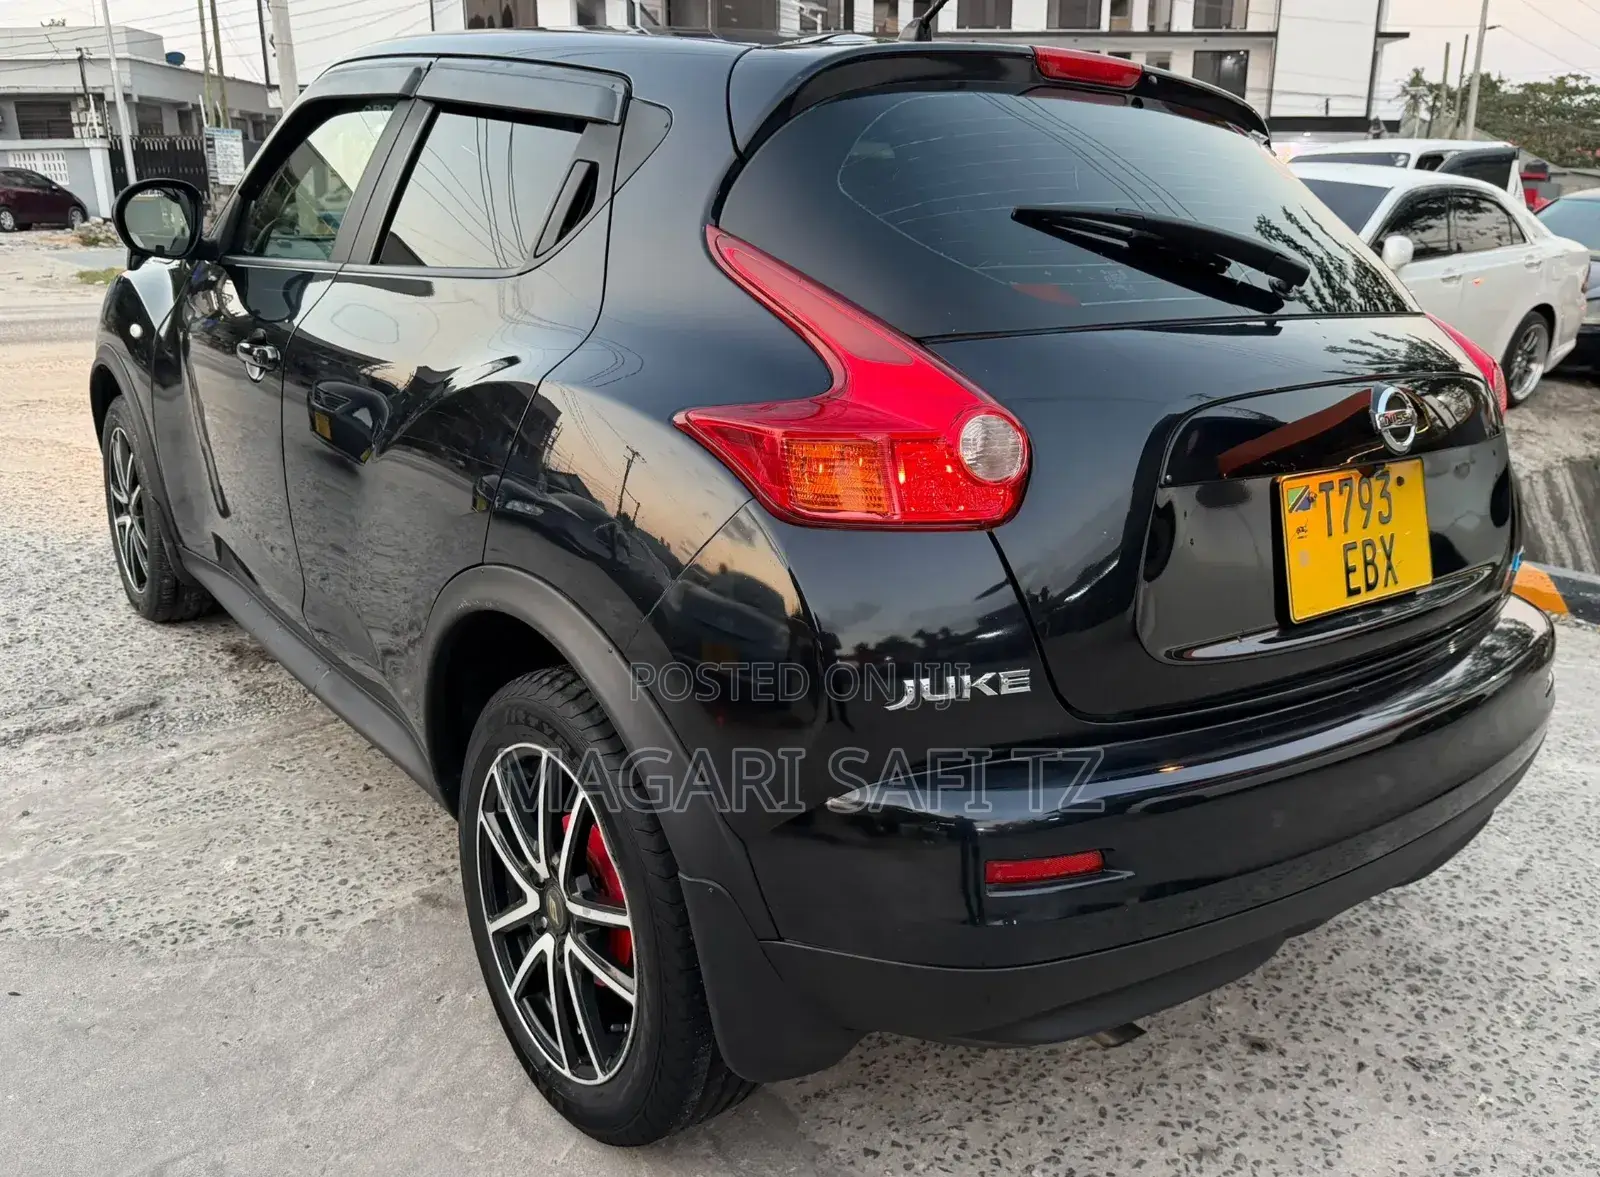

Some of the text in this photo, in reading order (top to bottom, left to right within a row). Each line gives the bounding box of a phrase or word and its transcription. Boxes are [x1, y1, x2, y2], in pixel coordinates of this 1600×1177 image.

[1319, 471, 1393, 536] T793
[1343, 533, 1399, 598] EBX
[885, 669, 1032, 711] JUKE
